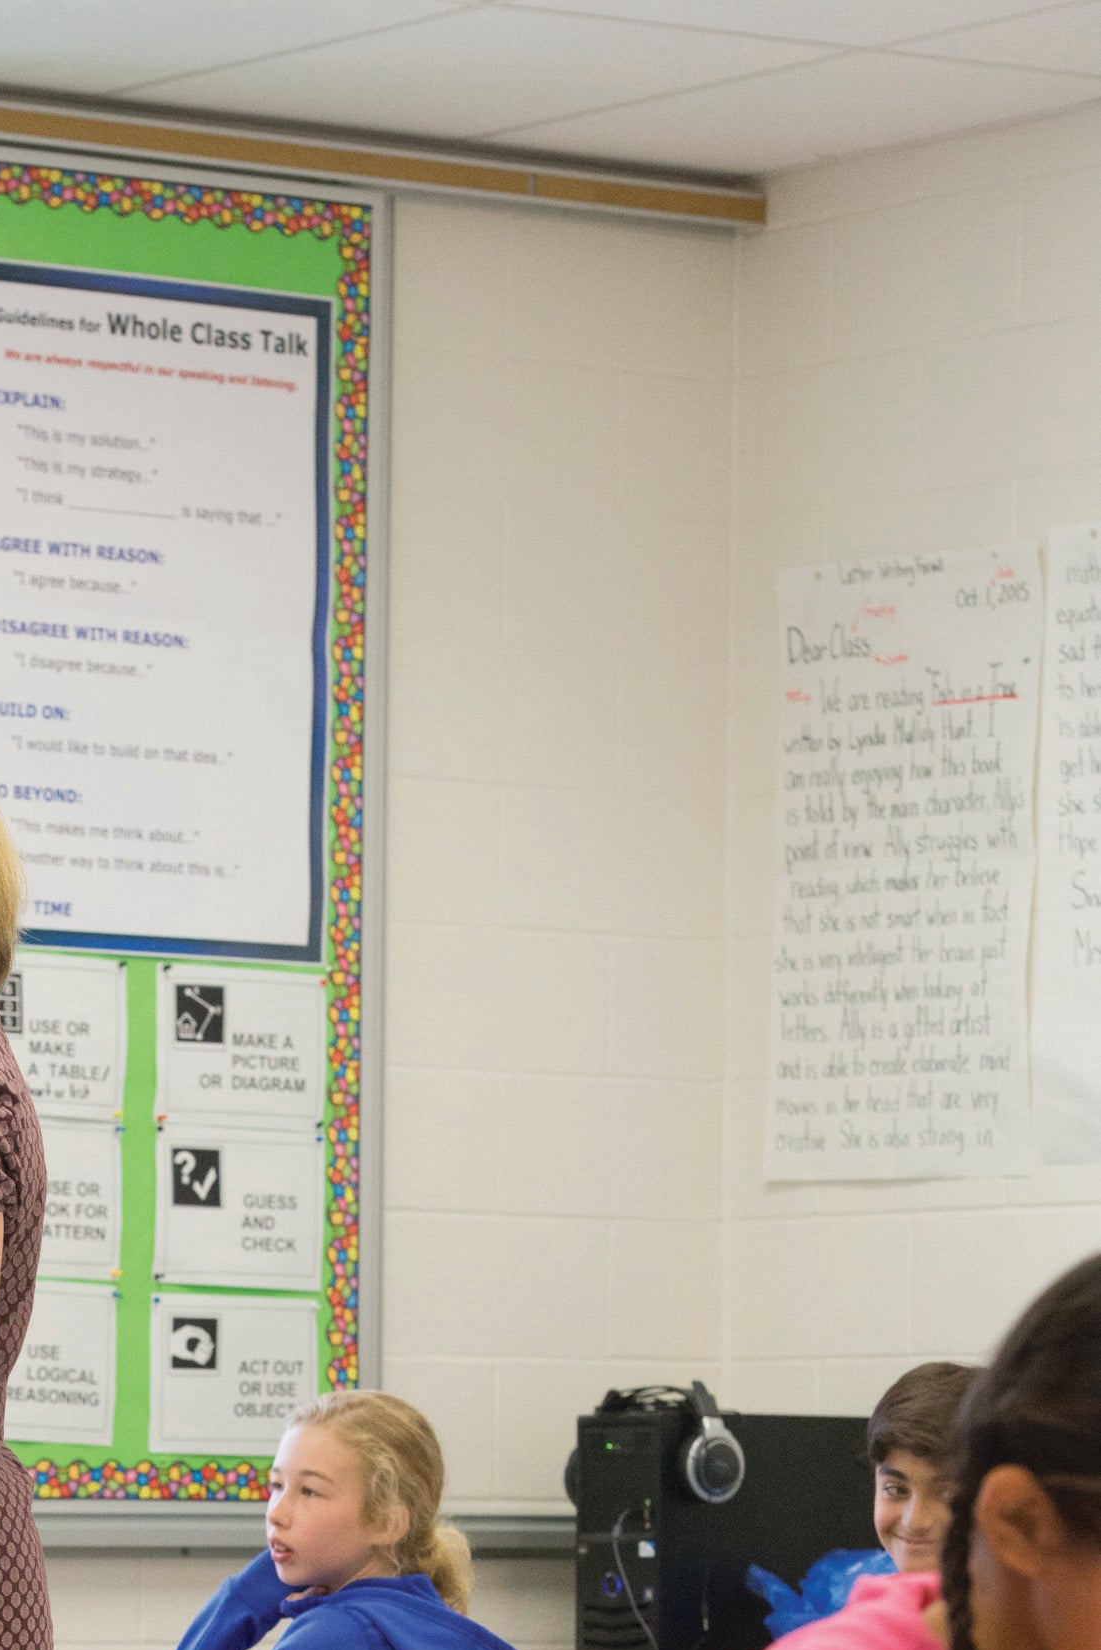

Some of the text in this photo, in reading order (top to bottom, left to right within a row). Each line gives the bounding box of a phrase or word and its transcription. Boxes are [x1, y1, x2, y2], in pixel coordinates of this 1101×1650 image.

[79, 316, 101, 333] for
[107, 312, 182, 343] Whole
[190, 321, 252, 351] Class
[260, 329, 308, 356] Talk
[4, 349, 20, 360] We
[24, 352, 41, 363] are
[46, 355, 83, 367] always
[52, 429, 62, 443] is
[67, 432, 86, 448] my
[53, 461, 62, 475] is
[67, 463, 86, 480] my
[31, 489, 64, 506] think
[47, 540, 91, 559] WITH
[96, 544, 165, 566] REASON:
[29, 573, 66, 592] agree
[74, 625, 117, 643] WITH
[122, 629, 189, 649] REASON:
[786, 622, 871, 664] Dear Class
[41, 704, 70, 721] ON:
[26, 738, 63, 754] would
[68, 739, 89, 757] like
[92, 742, 106, 758] to
[109, 743, 141, 761] build
[12, 784, 83, 804] BEYOND:
[34, 899, 72, 918] TIME
[28, 1018, 91, 1037] USE OR
[28, 1039, 75, 1058] MAKE
[232, 1031, 295, 1050] MAKE A
[27, 1061, 39, 1077] A
[231, 1053, 301, 1073] PICTURE
[199, 1072, 307, 1093] OR DIAGRAM
[47, 1180, 100, 1198] SE OR
[46, 1201, 109, 1220] OK FOR
[242, 1192, 298, 1212] GUESS
[43, 1222, 107, 1241] ATTERN
[241, 1213, 276, 1231] AND
[241, 1235, 298, 1254] CHECK
[26, 1342, 60, 1361] USE
[26, 1364, 97, 1386] LOGICAL
[238, 1359, 304, 1377] ACT OUT
[5, 1384, 101, 1408] REASONING
[238, 1381, 298, 1398] OR USE
